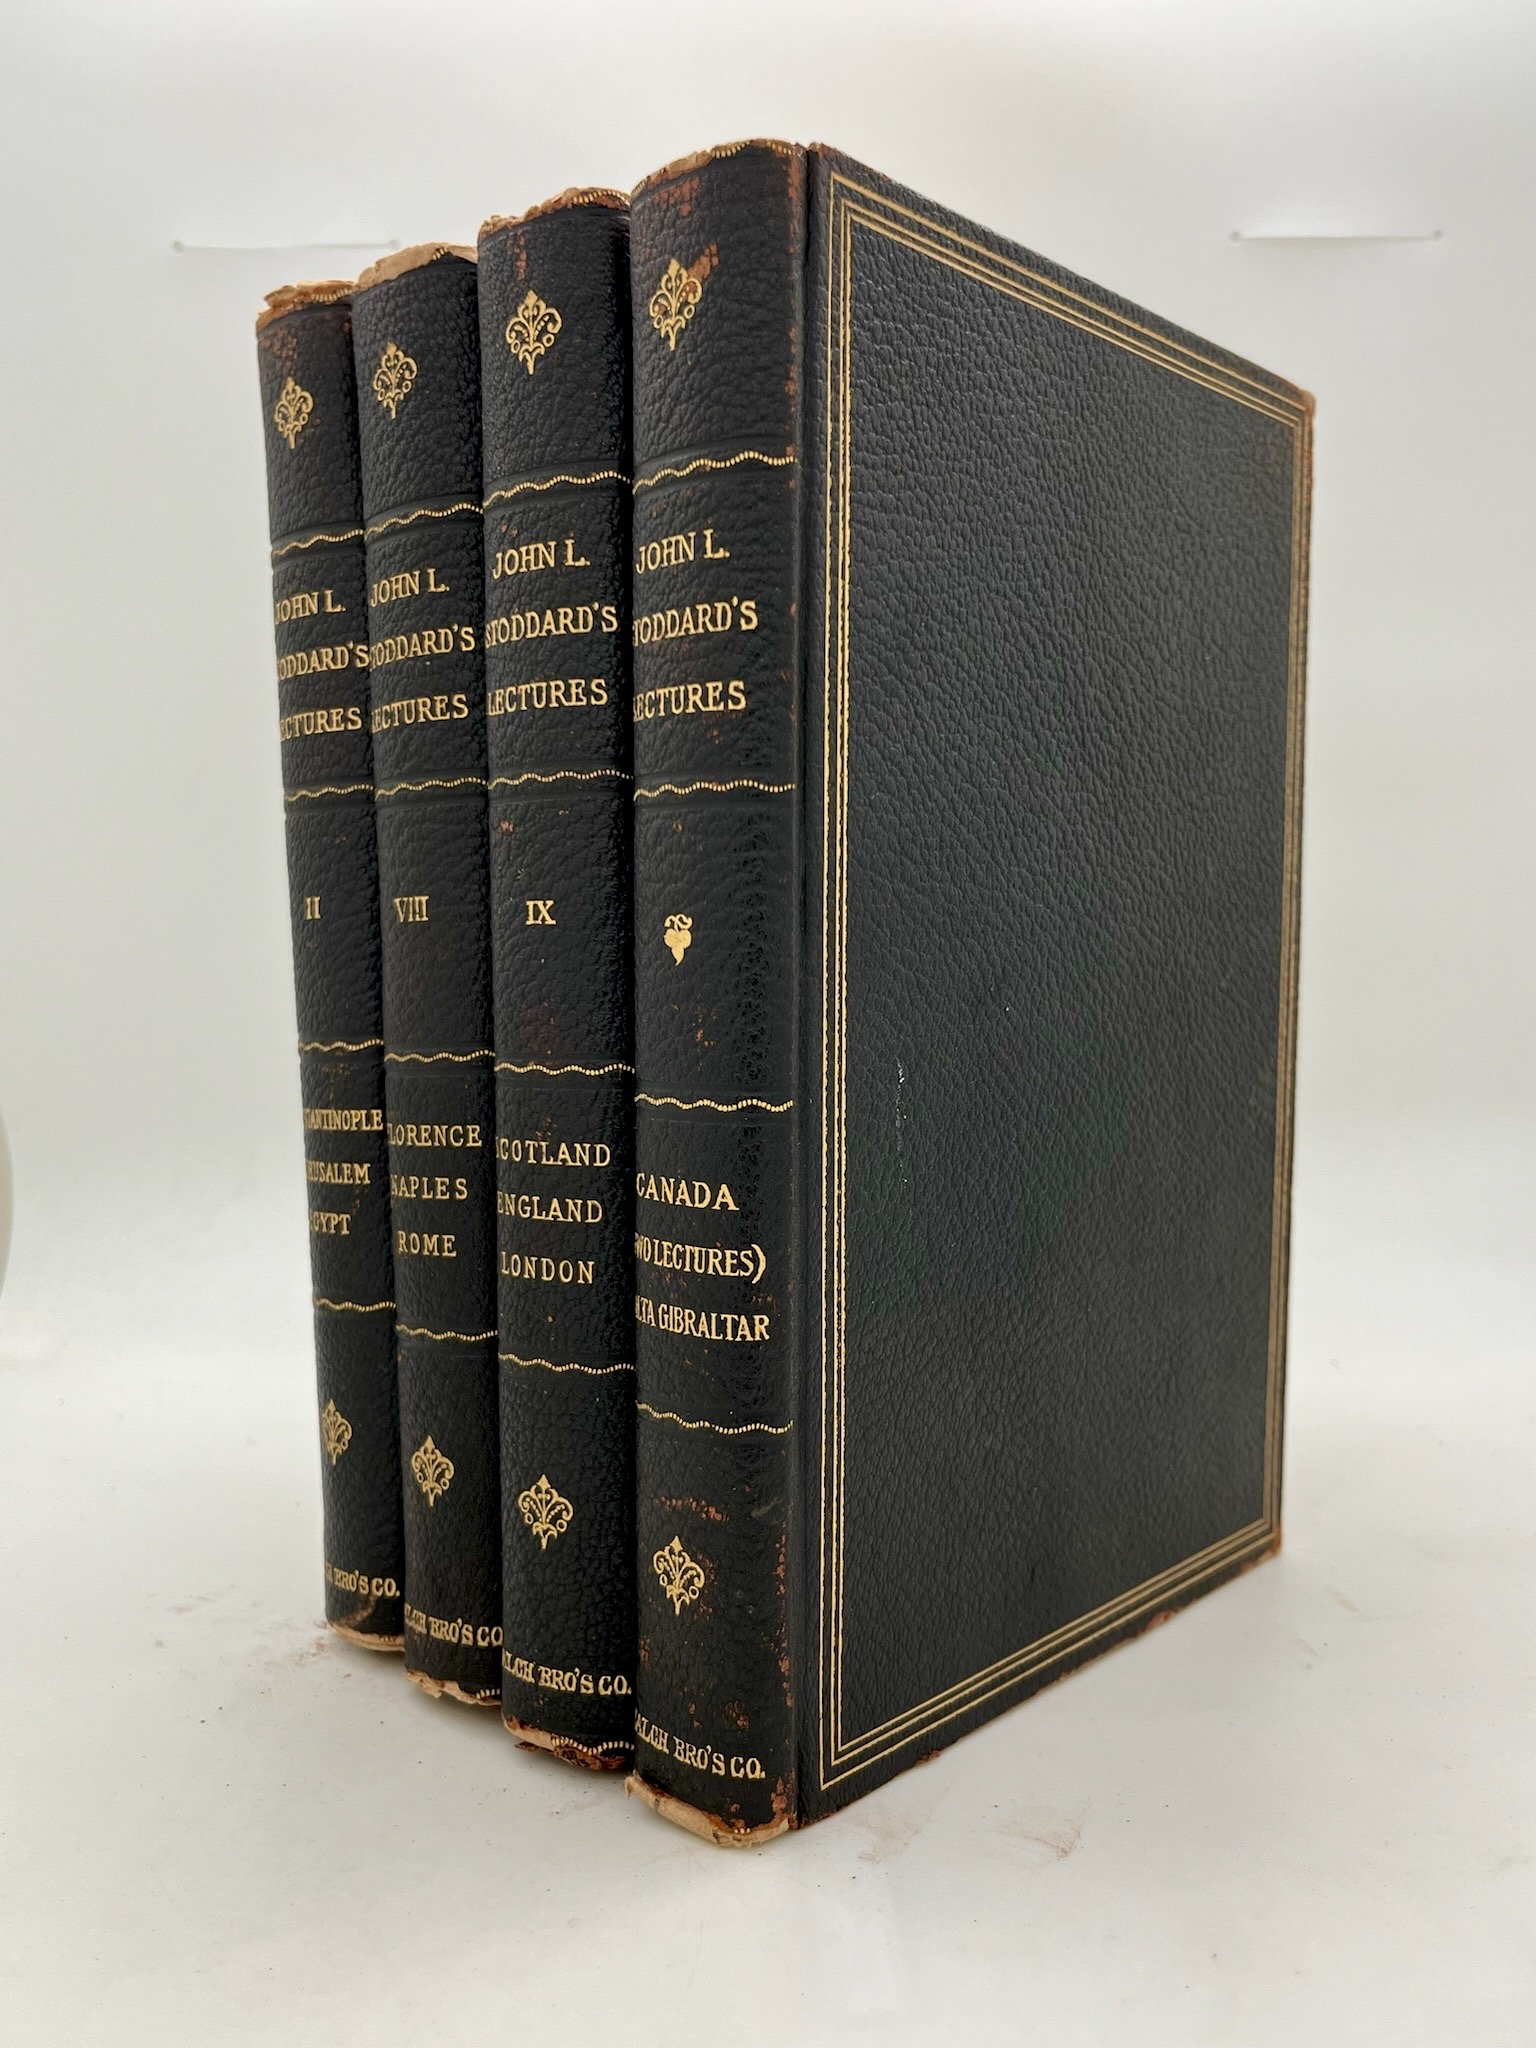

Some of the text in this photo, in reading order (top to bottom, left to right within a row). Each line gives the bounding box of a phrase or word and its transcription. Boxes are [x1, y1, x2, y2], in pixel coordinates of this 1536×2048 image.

[492, 539, 591, 580] JOHN L.
[635, 529, 731, 575] JOHN L.
[370, 568, 450, 608] JOHN L.
[274, 589, 346, 626] JOHN L.
[485, 602, 619, 649] STODDARD'S
[277, 641, 369, 681] ODDARD'S
[371, 694, 469, 733] LECTURES
[488, 678, 609, 716] LECTURES
[280, 707, 363, 743] ECTURES
[305, 896, 321, 921] II
[393, 896, 429, 923] VIII
[525, 900, 556, 926] IX
[306, 1160, 371, 1185] RUSALEM
[497, 1190, 603, 1224] ENGLAND
[636, 1172, 740, 1212] CANADA
[398, 1230, 457, 1257] ROME
[635, 1232, 767, 1284] WO LECTURES)
[502, 1251, 595, 1285] LONDON
[635, 1295, 771, 1342] LTA GIBRALTAR
[371, 1577, 400, 1597] CO.
[429, 1617, 474, 1647] BRO'S
[538, 1666, 594, 1695] BRO'S
[598, 1675, 632, 1696] CO.
[635, 1707, 766, 1780] ALCH BRO'S CO.
